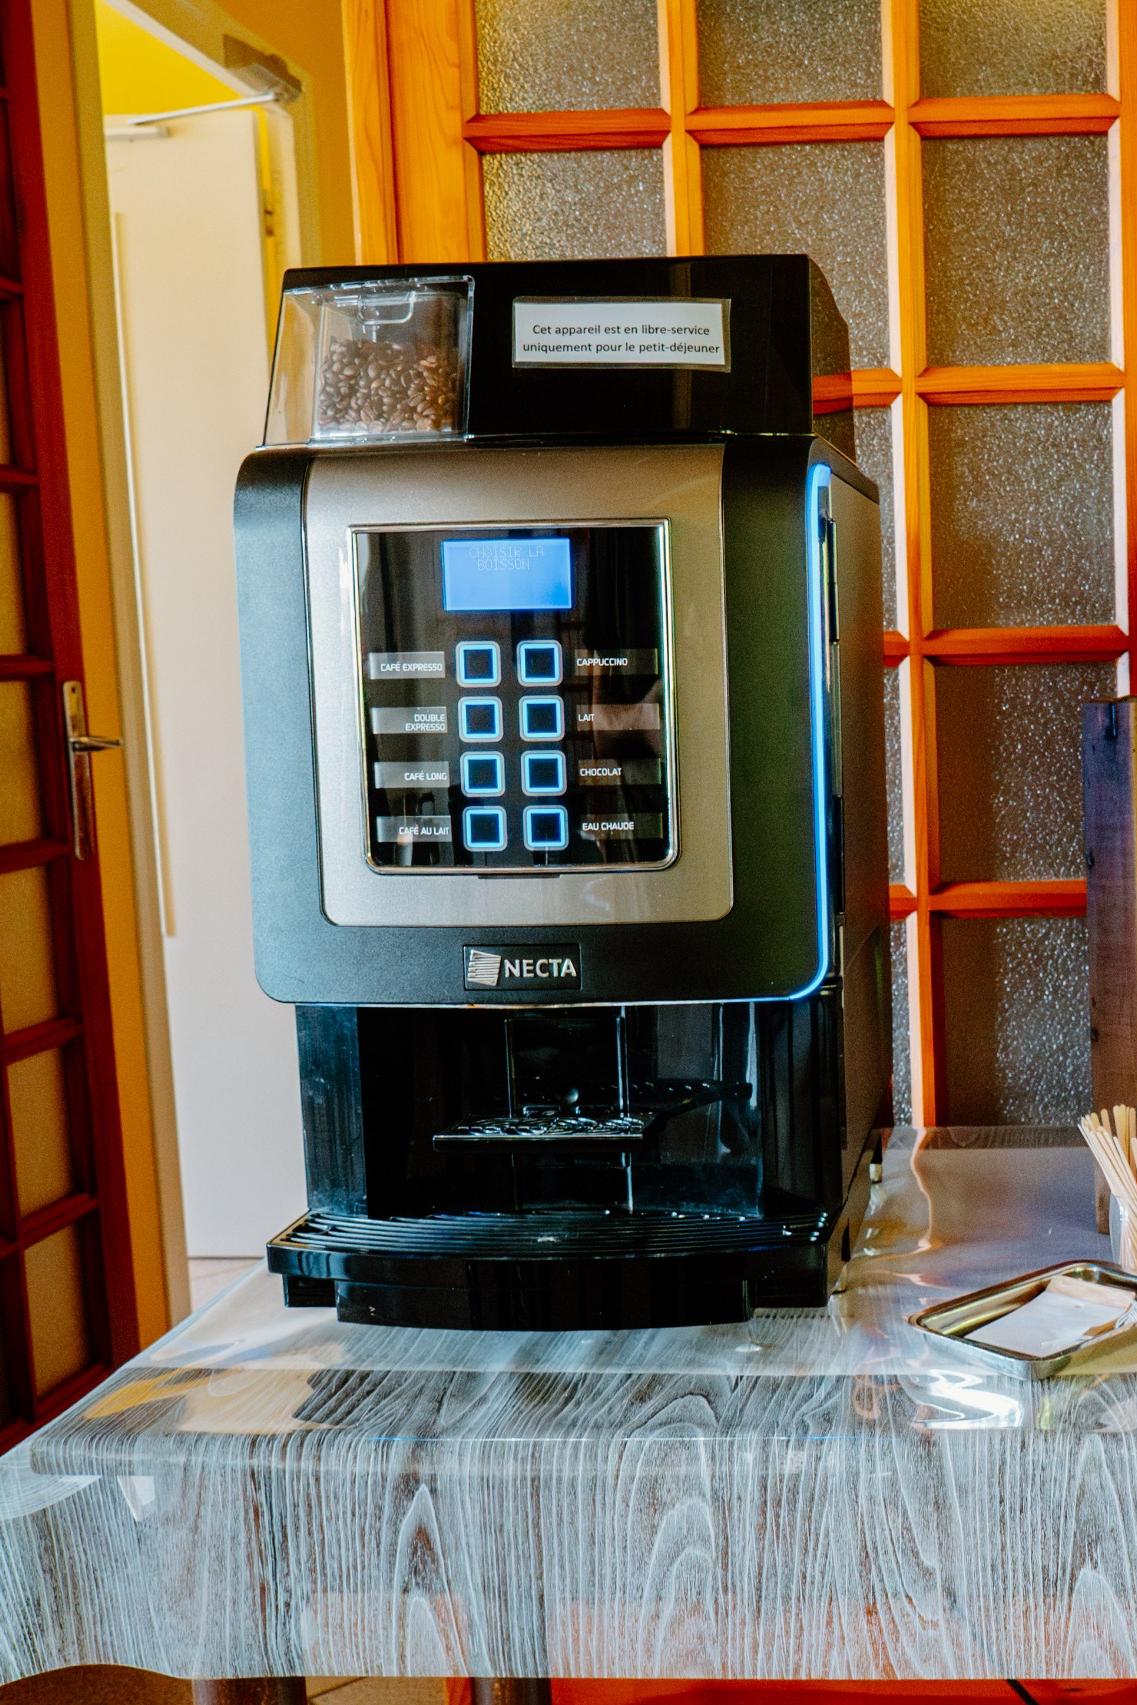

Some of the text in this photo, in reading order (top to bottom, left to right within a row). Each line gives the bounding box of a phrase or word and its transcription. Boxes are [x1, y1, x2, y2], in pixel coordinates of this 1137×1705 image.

[533, 325, 551, 334] Cet
[555, 324, 601, 337] appareil
[604, 326, 620, 335] est
[642, 324, 710, 336] libre-service
[523, 342, 720, 354] uniquement pour le petit-déjeuner
[380, 662, 443, 672] CAFÉ EXPRESSO
[576, 657, 628, 667] CAPPUCCINO
[414, 714, 445, 722] DOUBLE
[578, 713, 594, 722] LAIT
[405, 722, 445, 731] EXPRESSO
[404, 770, 447, 781] CAFÉ LONG
[580, 767, 622, 777] CHOCOLAT
[399, 824, 449, 835] CAFÉ AU LAIT
[582, 822, 635, 831] EAU CHAUDE
[504, 958, 577, 978] NECTA
